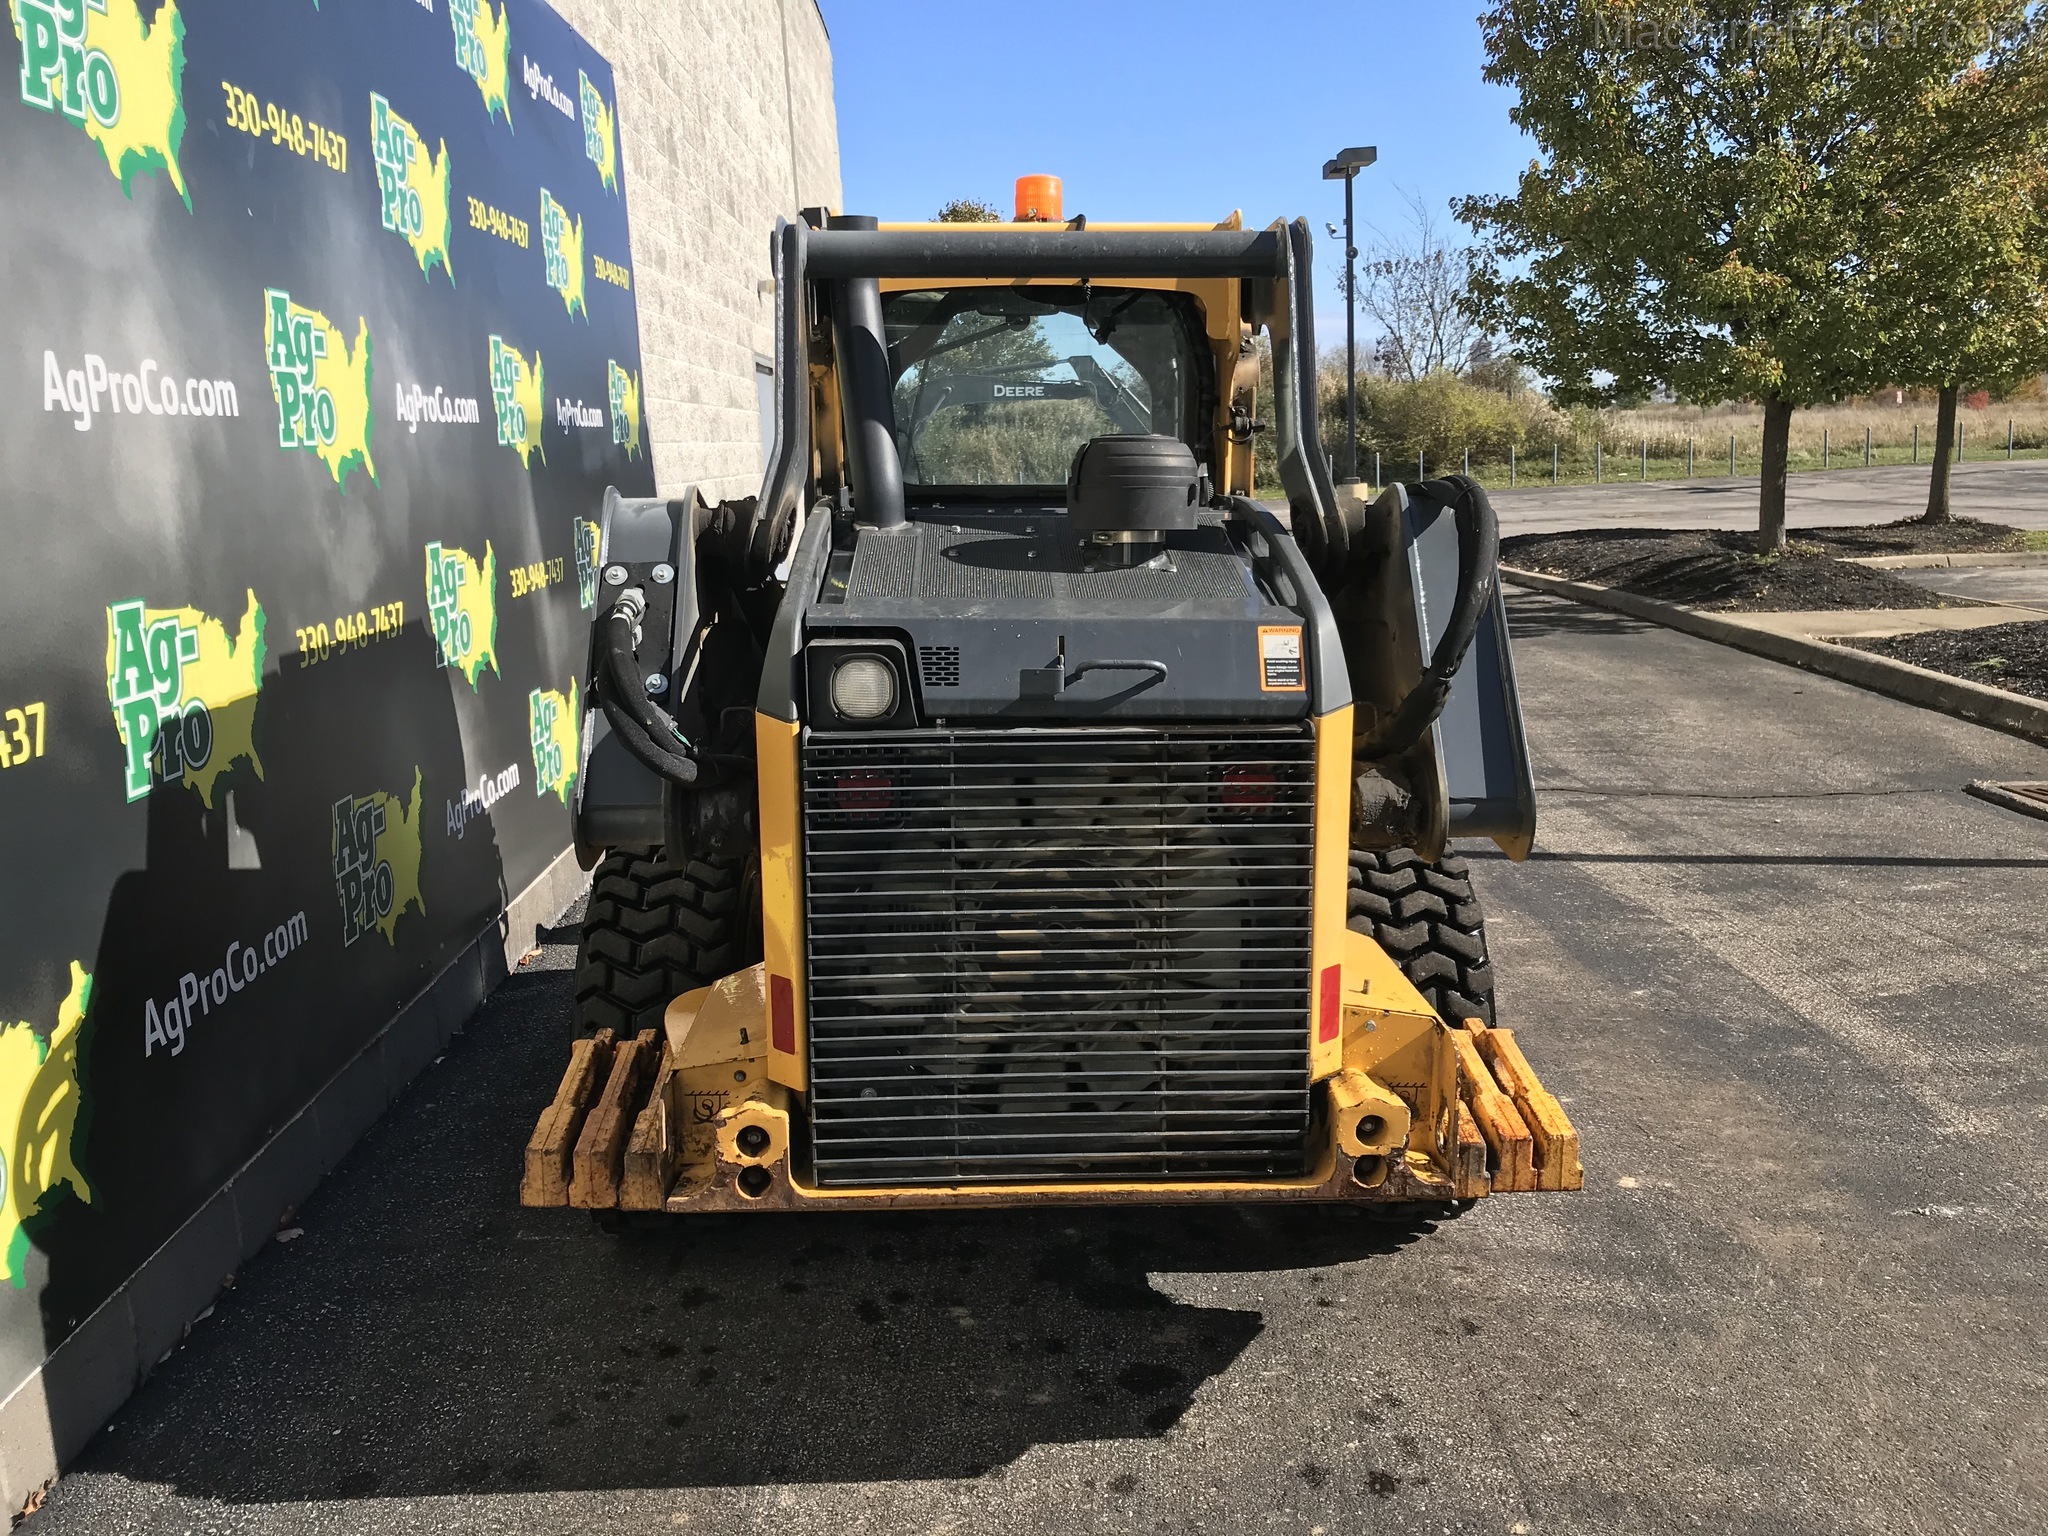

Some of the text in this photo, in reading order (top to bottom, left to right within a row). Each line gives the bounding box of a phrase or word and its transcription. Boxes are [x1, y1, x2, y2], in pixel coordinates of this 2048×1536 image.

[17, 0, 121, 126] Pro
[452, 6, 488, 81] Pro
[523, 54, 575, 122] AgProCo.com
[579, 69, 600, 128] Ag-
[221, 81, 347, 173] 330-948-7437
[371, 92, 416, 184] Ag-
[584, 114, 604, 165] Pro
[379, 160, 423, 236] Pro
[467, 196, 529, 249] 330-948-7437
[541, 188, 565, 251] Ag-
[545, 238, 569, 289] Pro
[267, 290, 327, 388] Ag-
[490, 335, 520, 402] Ag-
[44, 350, 239, 432] AgProCo.com
[276, 370, 337, 448] Pro
[396, 382, 480, 434] AgProCo.com
[495, 390, 527, 445] Pro
[556, 398, 604, 435] AgProCo.com
[993, 384, 1045, 397] DEERE
[426, 541, 465, 615] Ag-
[509, 557, 564, 598] 330-948-7437
[577, 560, 597, 609] Pr
[111, 600, 200, 711] Ag-
[295, 600, 404, 669] 330-948-7437
[431, 602, 473, 669] Pro
[119, 693, 213, 803] Pro
[530, 687, 558, 748] Ag-
[446, 763, 520, 840] AgProCo.com
[534, 738, 562, 798] Pro
[335, 793, 386, 876] Ag-
[339, 862, 394, 948] Pro
[144, 910, 309, 1058] AgProCo.com
